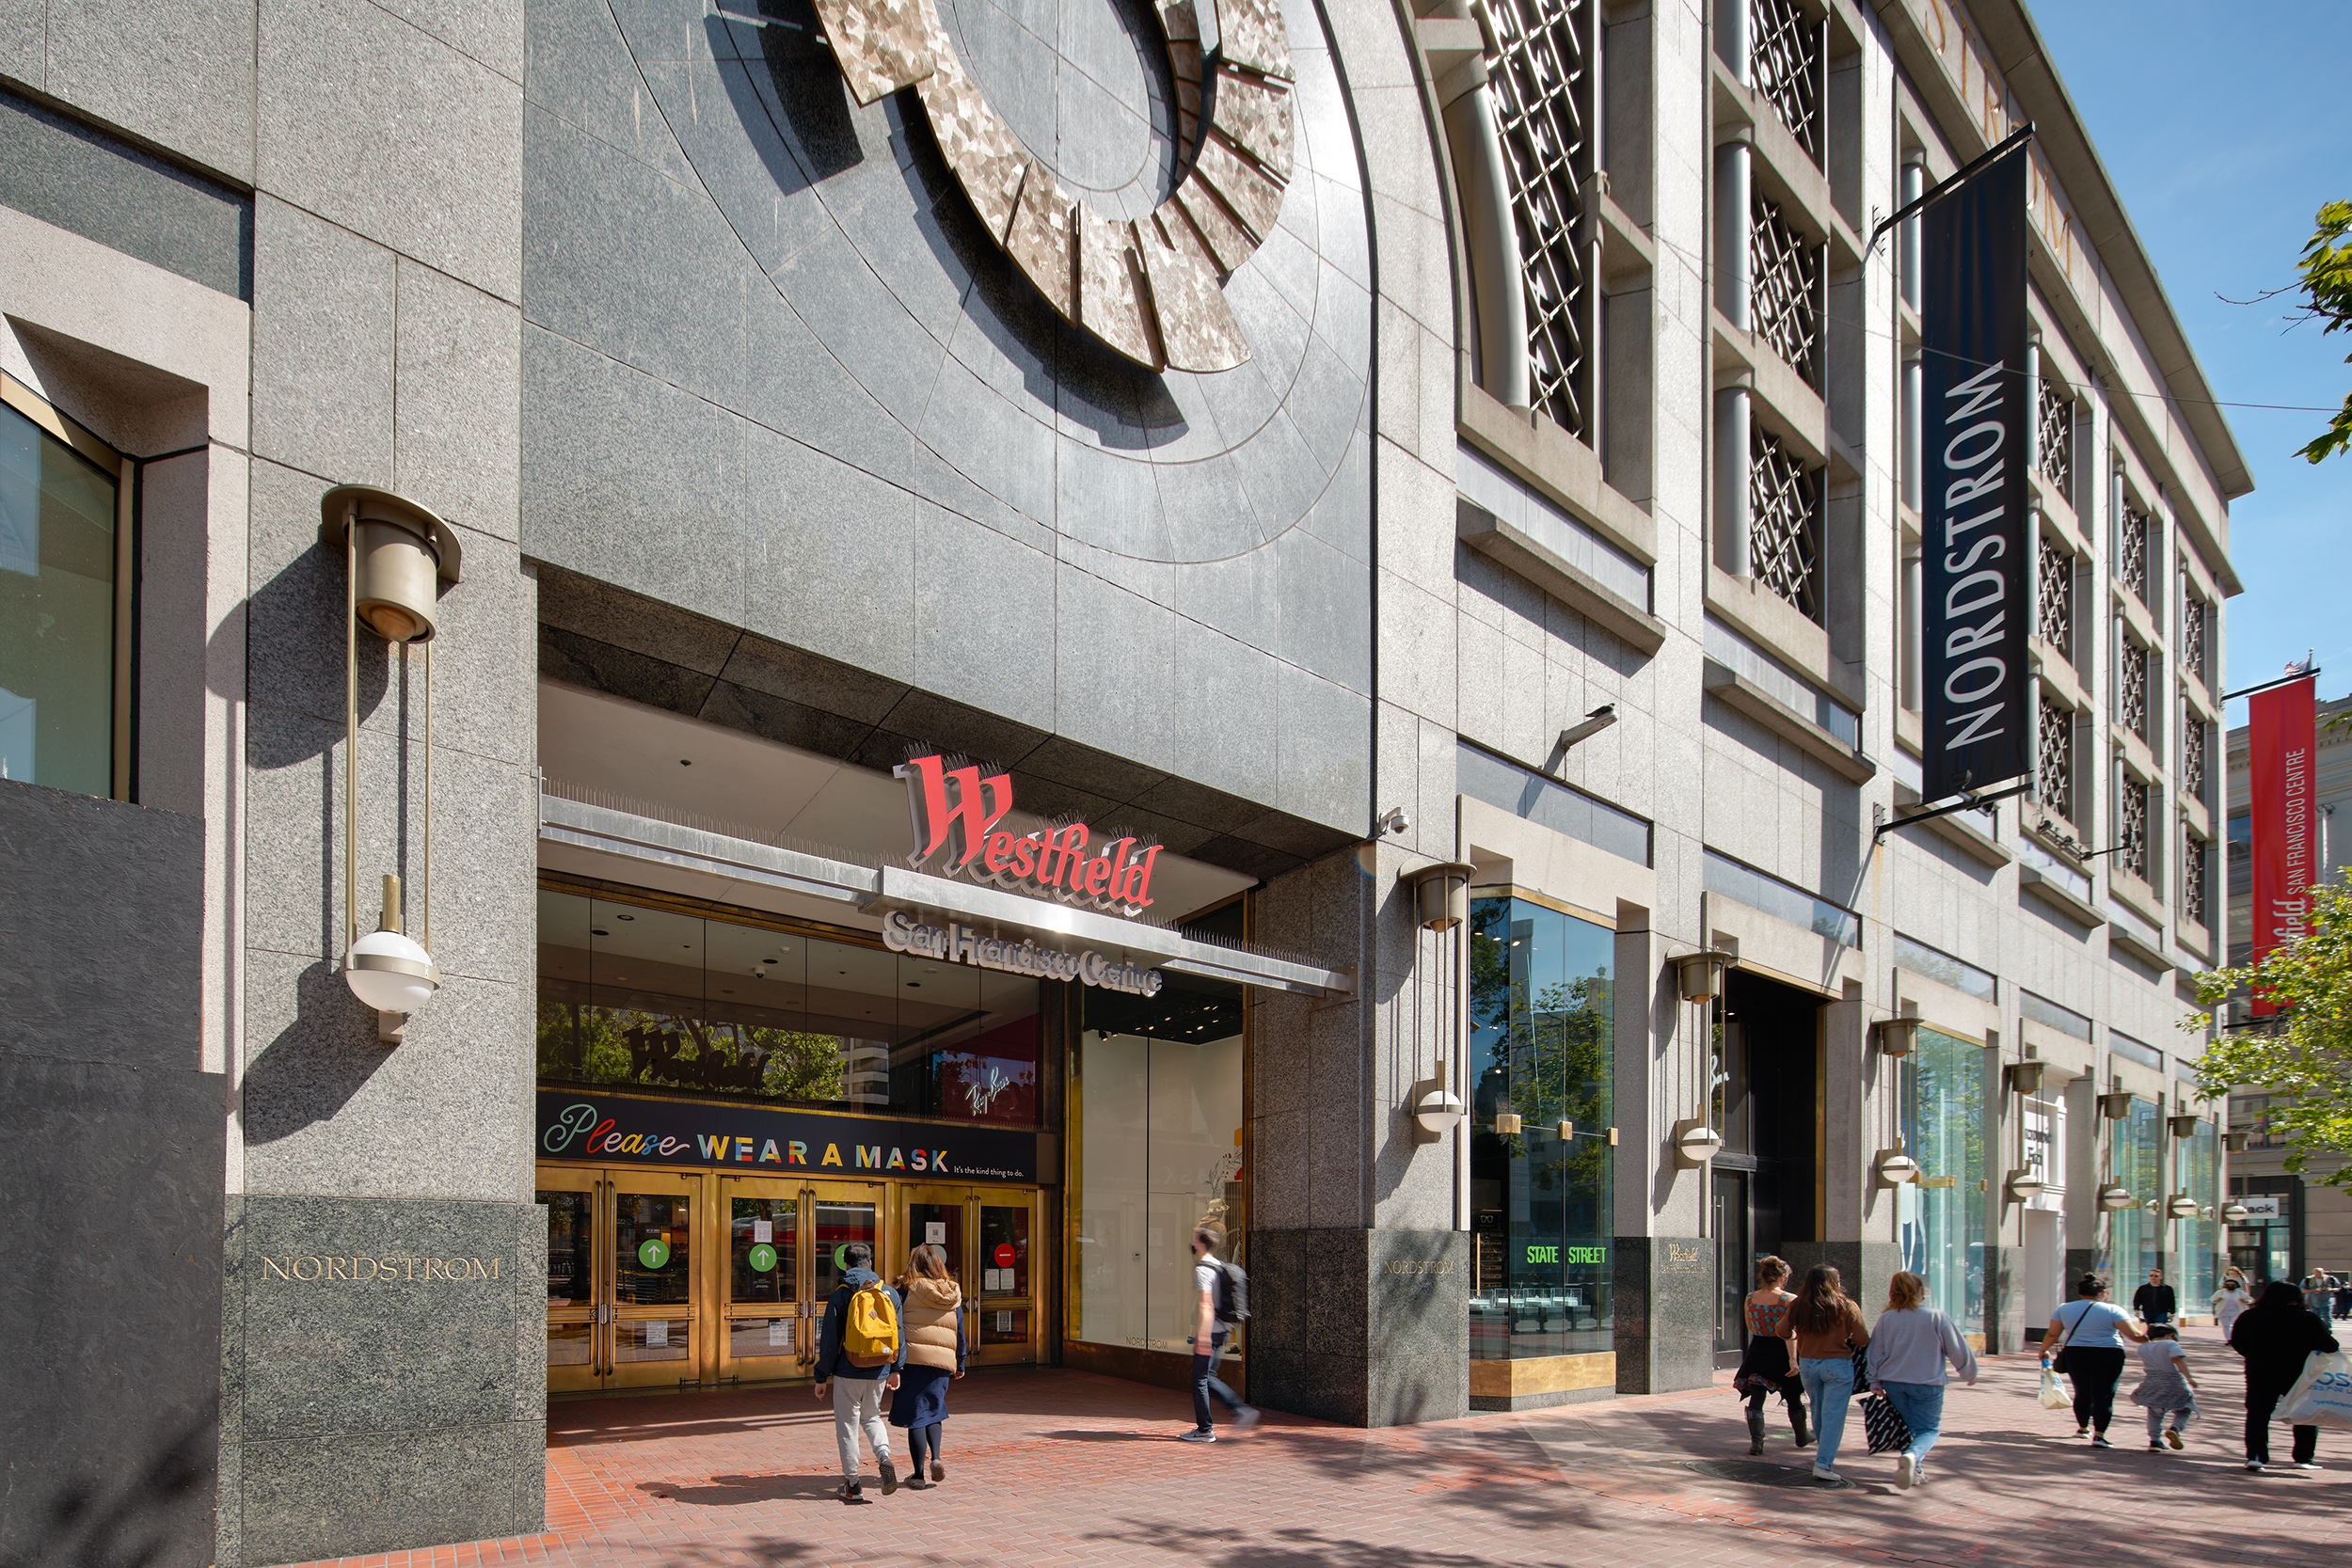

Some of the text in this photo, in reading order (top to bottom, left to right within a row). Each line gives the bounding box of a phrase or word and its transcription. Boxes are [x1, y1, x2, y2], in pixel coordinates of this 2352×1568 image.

[1943, 358, 2006, 751] NORDSTROM
[2286, 748, 2305, 796] CENTRE
[905, 754, 1164, 911] Westfield
[2286, 797, 2305, 868] FRANCISCO
[2286, 868, 2305, 895] SAN
[883, 911, 1163, 997] San Francisco Centre
[543, 1103, 948, 1173] Please WEAR A MASK
[954, 1165, 963, 1174] It's
[964, 1166, 975, 1175] the
[976, 1166, 990, 1175] kind
[990, 1168, 1007, 1179] thing
[2247, 1204, 2274, 1213] ack
[260, 1256, 502, 1280] NORDSTROM
[1384, 1259, 1454, 1274] NORDSTROM
[1526, 1245, 1607, 1264] STATE STREET
